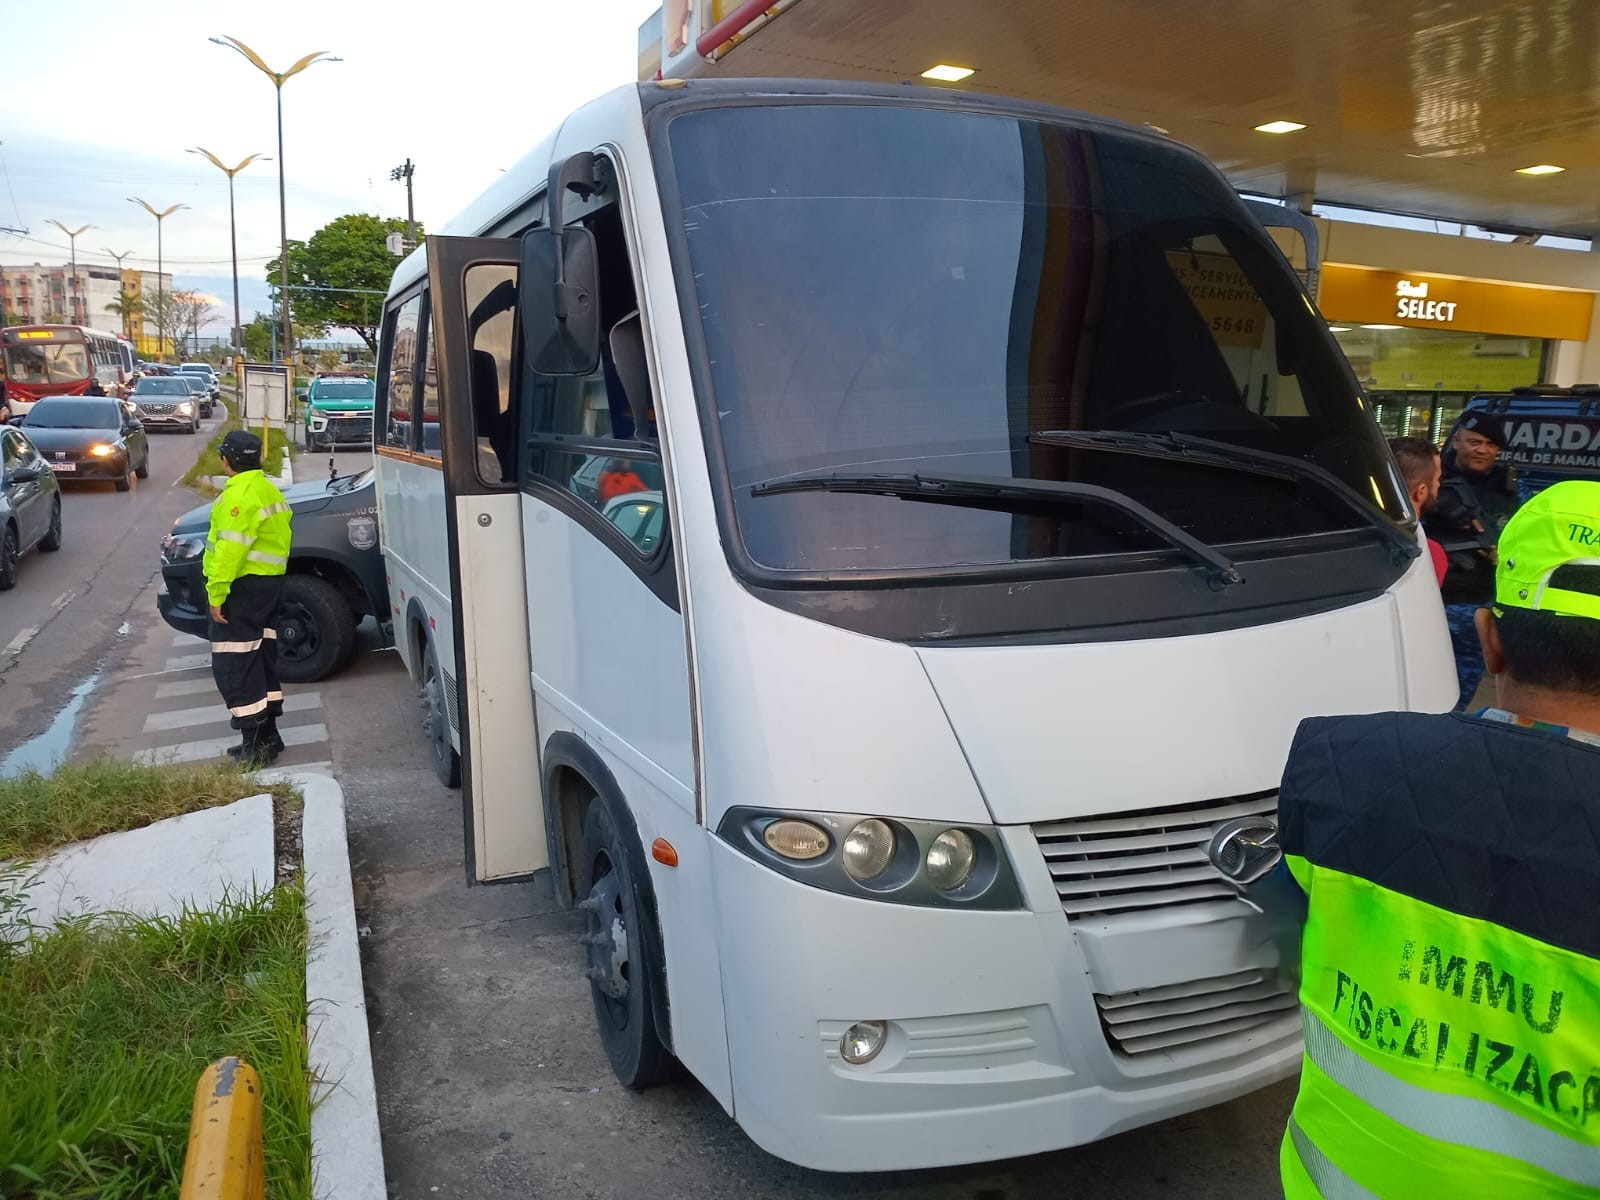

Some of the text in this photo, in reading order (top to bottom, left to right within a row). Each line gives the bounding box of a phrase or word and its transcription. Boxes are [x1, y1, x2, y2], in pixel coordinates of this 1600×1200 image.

[1397, 298, 1457, 321] SELECT
[1532, 453, 1551, 464] DE
[1398, 940, 1564, 1034] IMMU
